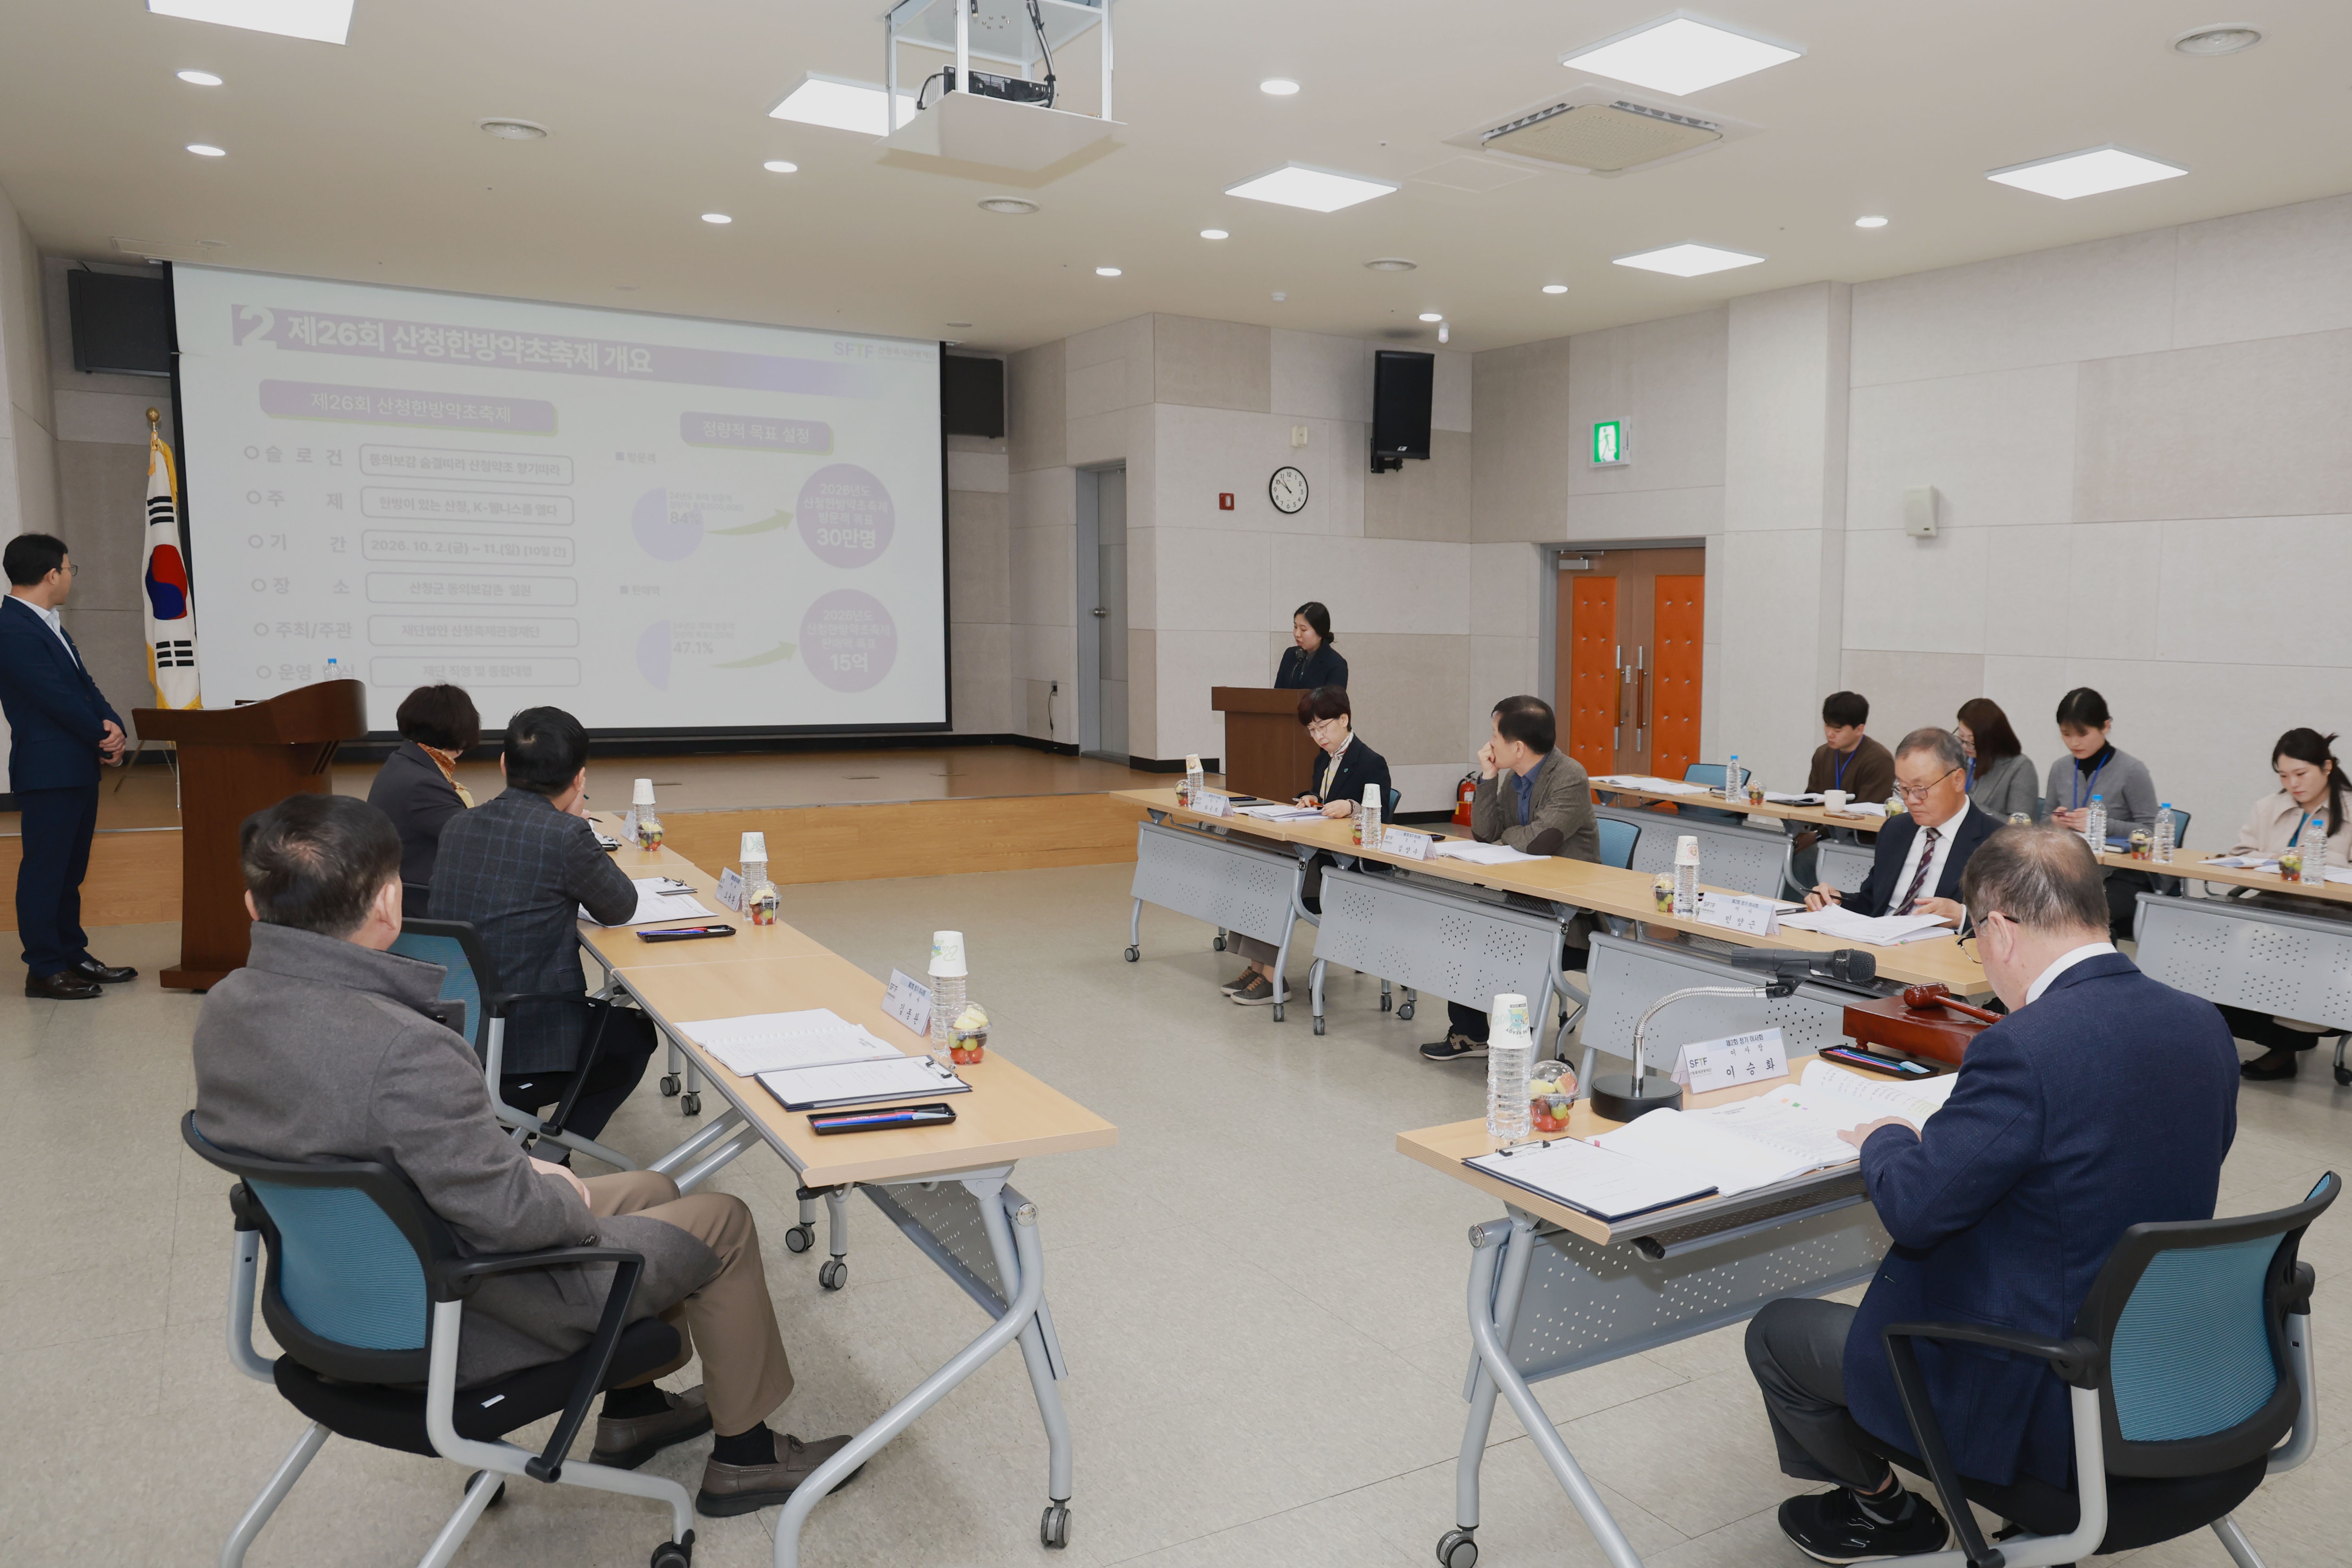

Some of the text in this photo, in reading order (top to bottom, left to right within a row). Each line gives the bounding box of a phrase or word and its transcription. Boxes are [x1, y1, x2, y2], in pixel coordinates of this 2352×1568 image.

[239, 306, 277, 348] 2
[288, 316, 653, 373] 제26회 산청한방약초축제 개요
[834, 342, 874, 358] SFTF
[311, 393, 511, 423] 제26회 산청한방약초축제
[702, 421, 810, 444] 정량적 목표 설정
[369, 453, 560, 476] 동의보감 숨결따라 산청약초 향기따라
[627, 452, 656, 464] 방문객
[821, 483, 871, 496] 2026년도
[379, 496, 415, 511] 한방이
[418, 498, 441, 512] 있는
[445, 500, 470, 513] 산청,
[535, 503, 557, 517] 열다
[803, 496, 888, 513] 산청한방약초축제
[670, 511, 700, 525] 84%
[818, 511, 874, 525] 방문객 목표
[816, 528, 875, 549] 30만명
[371, 539, 410, 551] 2026.
[412, 541, 432, 552] 10.
[436, 541, 469, 555] 2.(금)
[410, 582, 531, 597] 산청군 동의보감촌 일원
[631, 585, 660, 596] 판매액
[823, 610, 874, 622] 2026년도
[276, 621, 352, 639] 주최/주관
[402, 625, 540, 638] 재단법인 산청축제관광재단
[673, 641, 714, 654] 47.1%
[830, 652, 868, 673] 15억
[278, 663, 312, 681] 운영
[423, 665, 445, 677] 재단
[449, 665, 471, 677] 직영
[474, 665, 485, 678] 및
[1740, 1037, 1748, 1045] 정기
[1750, 1034, 1763, 1042] 이사회
[1690, 1057, 1707, 1068] SFTF
